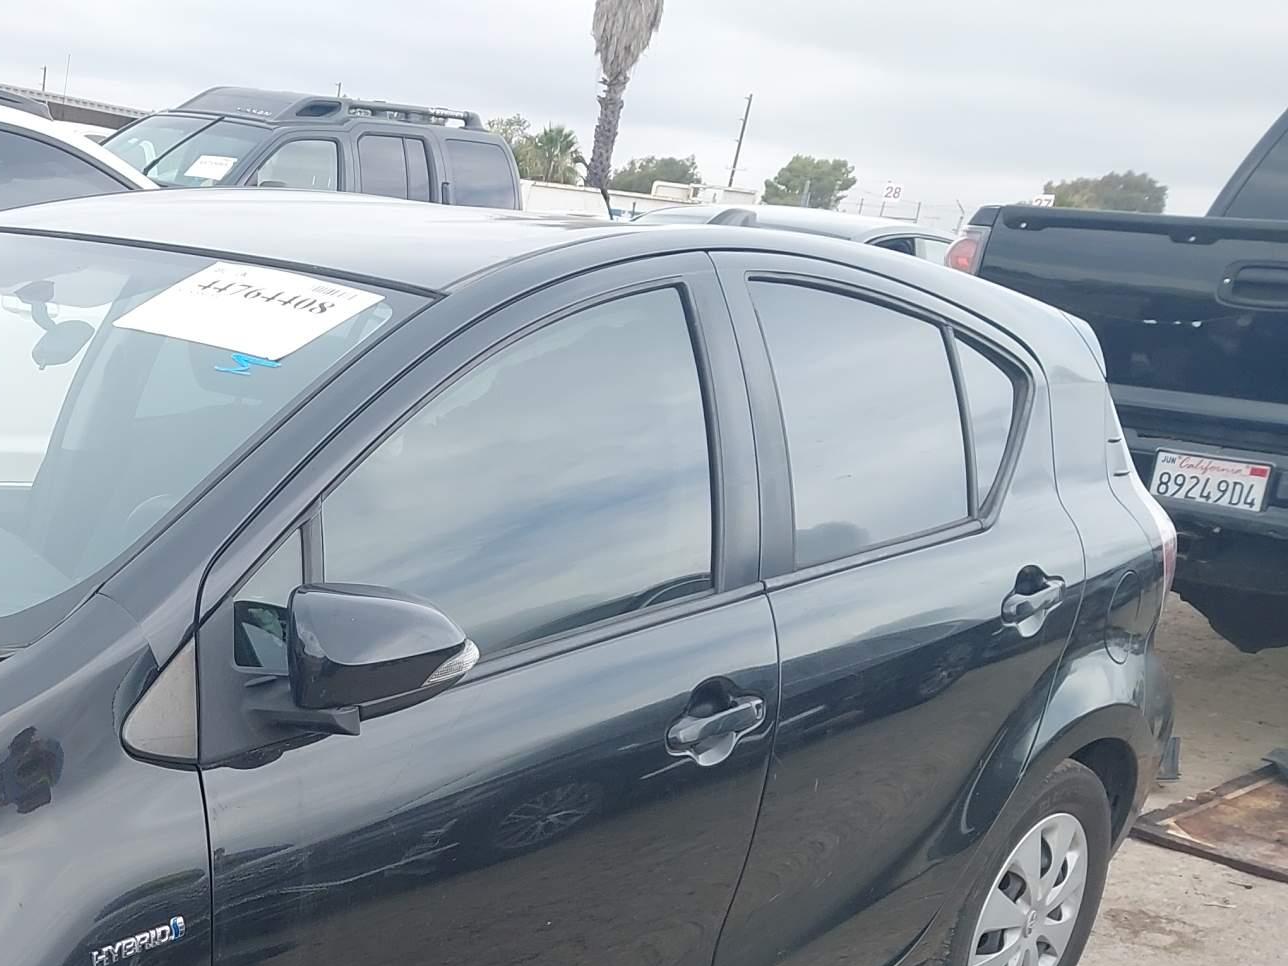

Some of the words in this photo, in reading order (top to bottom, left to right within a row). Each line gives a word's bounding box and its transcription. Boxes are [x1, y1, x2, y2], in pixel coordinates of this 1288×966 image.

[883, 185, 902, 199] 28
[197, 279, 335, 315] 44764408
[1161, 455, 1177, 465] JUN
[1178, 455, 1243, 475] California
[1156, 471, 1256, 509] 89249D4
